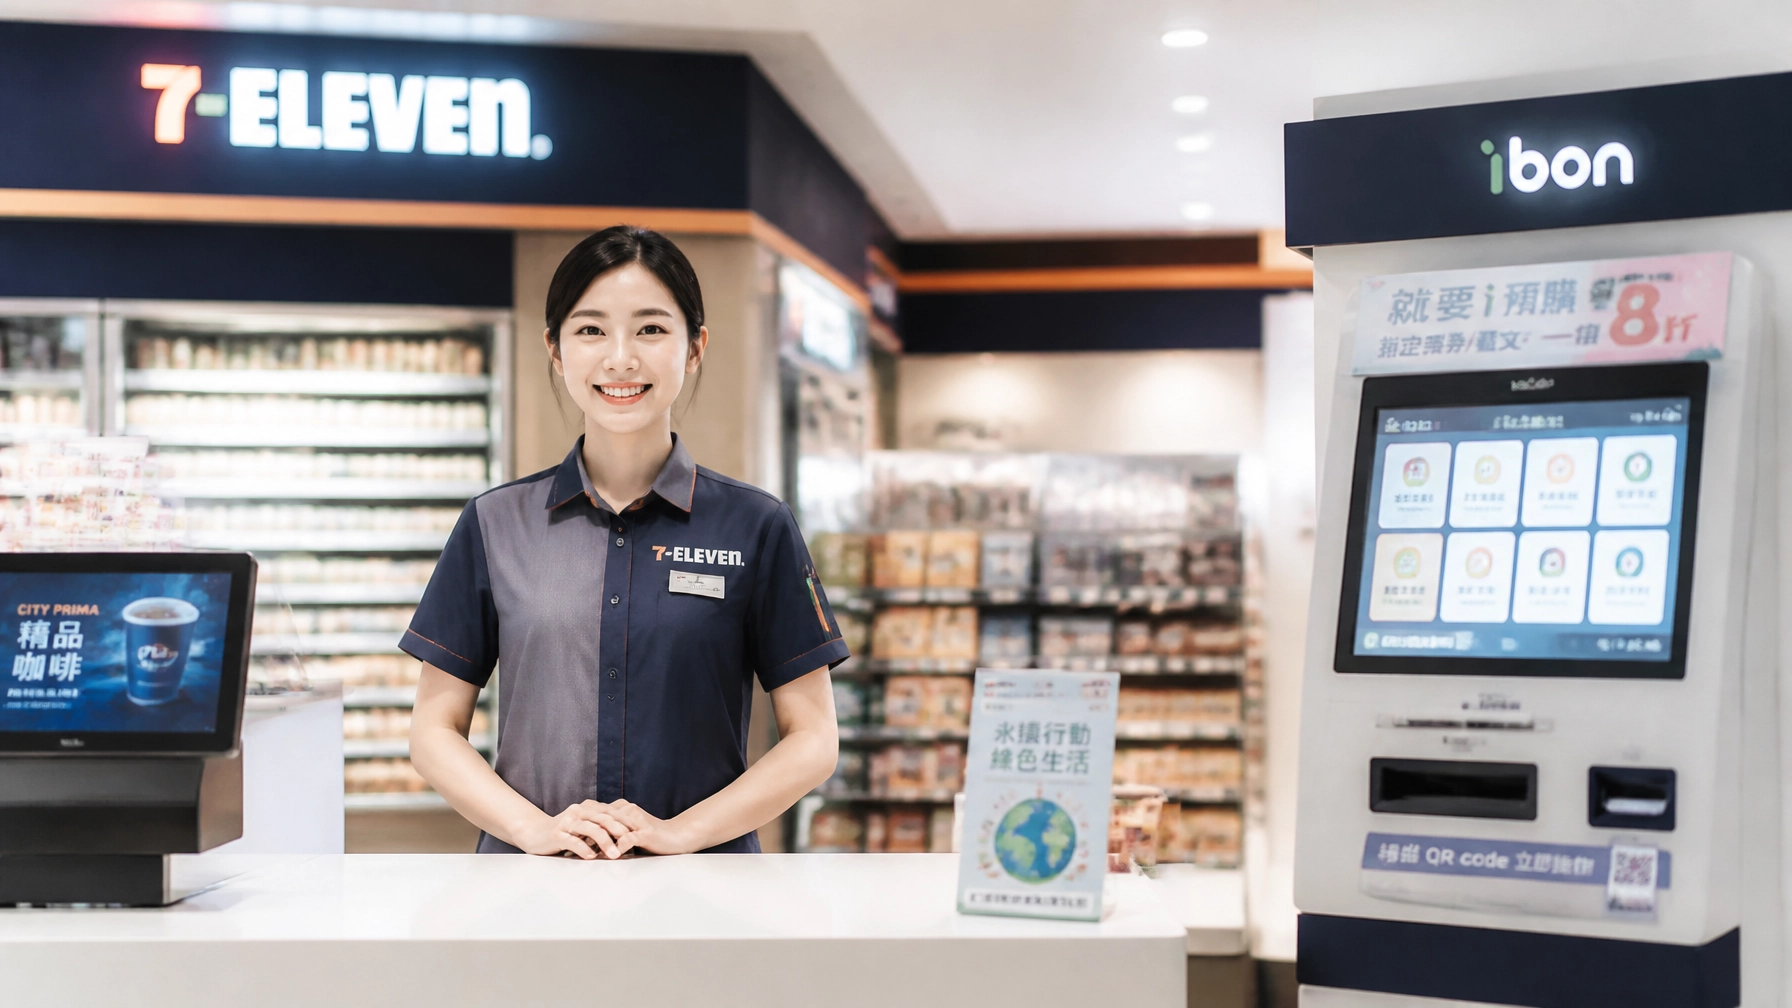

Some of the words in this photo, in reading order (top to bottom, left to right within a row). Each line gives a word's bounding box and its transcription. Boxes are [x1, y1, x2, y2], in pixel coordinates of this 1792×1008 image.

[1480, 135, 1634, 195] ibon
[17, 603, 51, 616] CITY
[53, 603, 100, 616] PRIMA
[12, 651, 83, 681] 咖啡
[1425, 846, 1455, 867] QR
[1459, 851, 1510, 869] code
